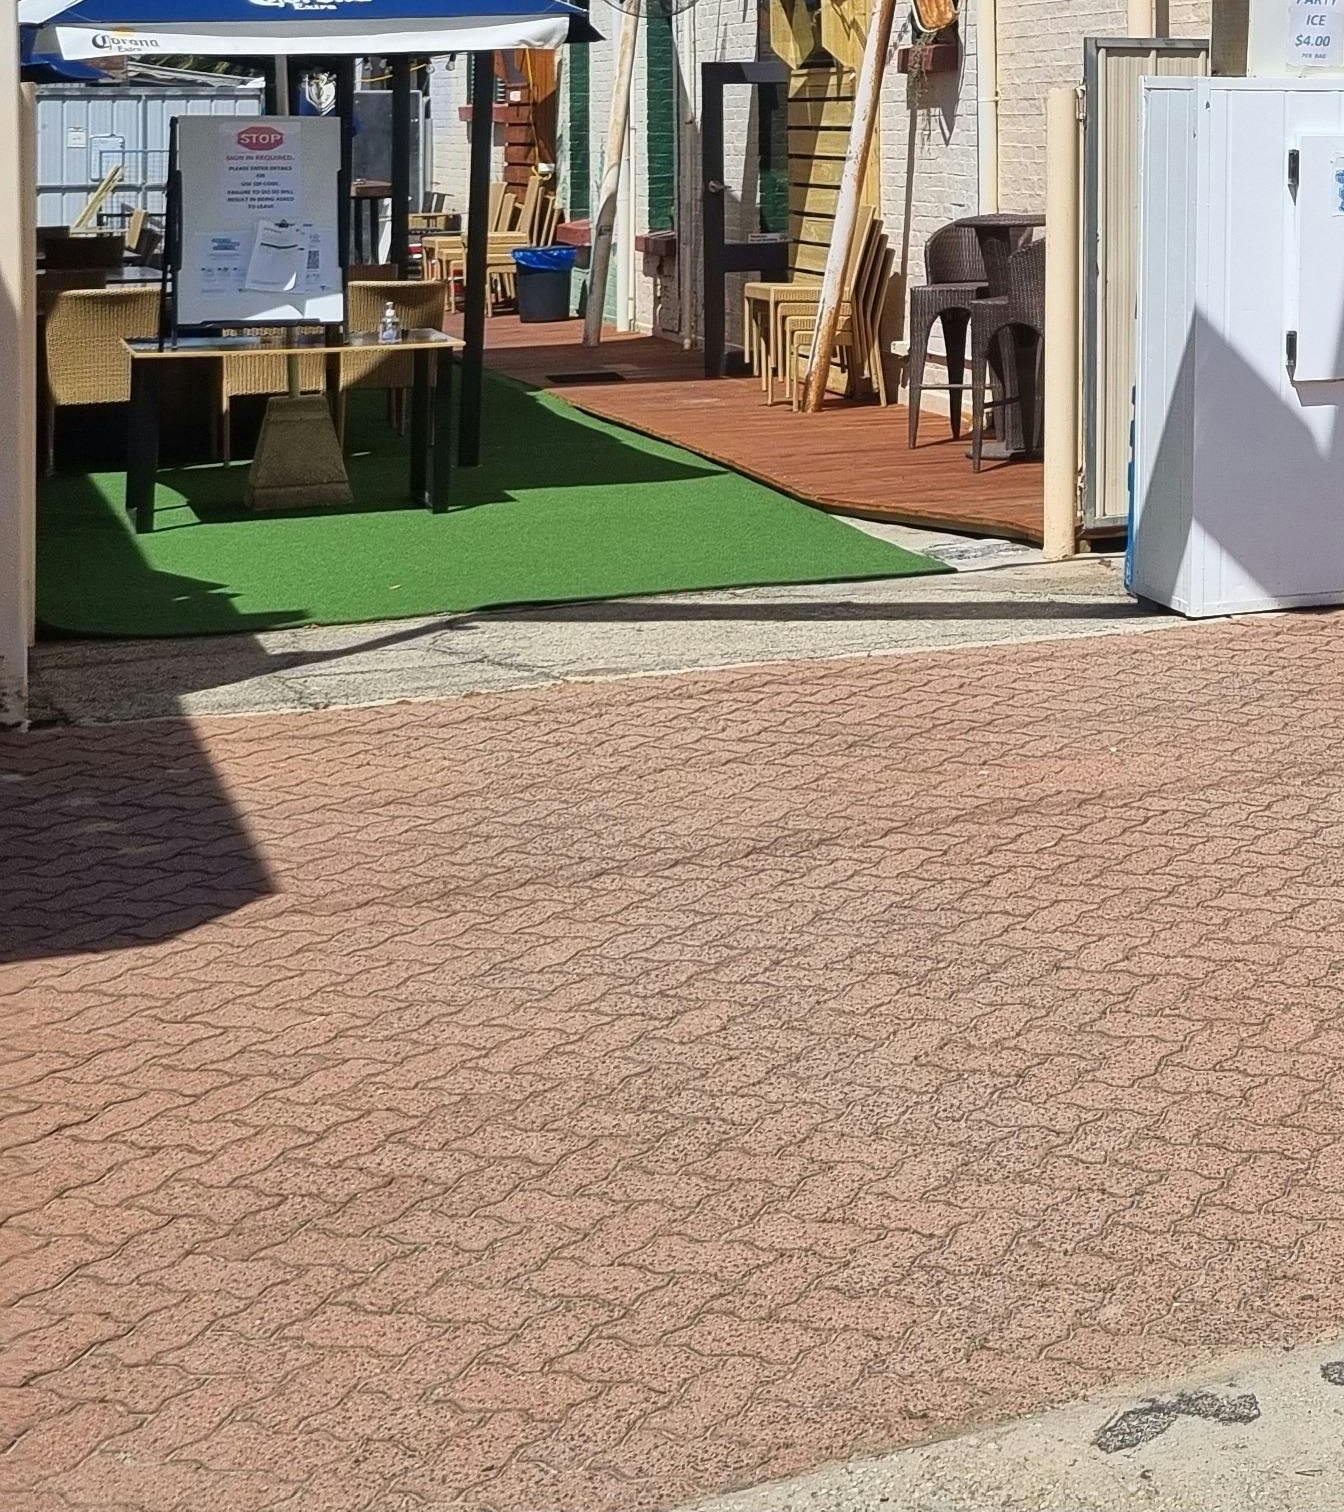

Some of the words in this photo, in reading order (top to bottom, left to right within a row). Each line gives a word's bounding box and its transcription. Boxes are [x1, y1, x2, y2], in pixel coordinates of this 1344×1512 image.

[1306, 14, 1327, 27] ICE
[91, 33, 161, 49] Corona
[1294, 33, 1332, 49] $4.00
[240, 133, 282, 144] STOP
